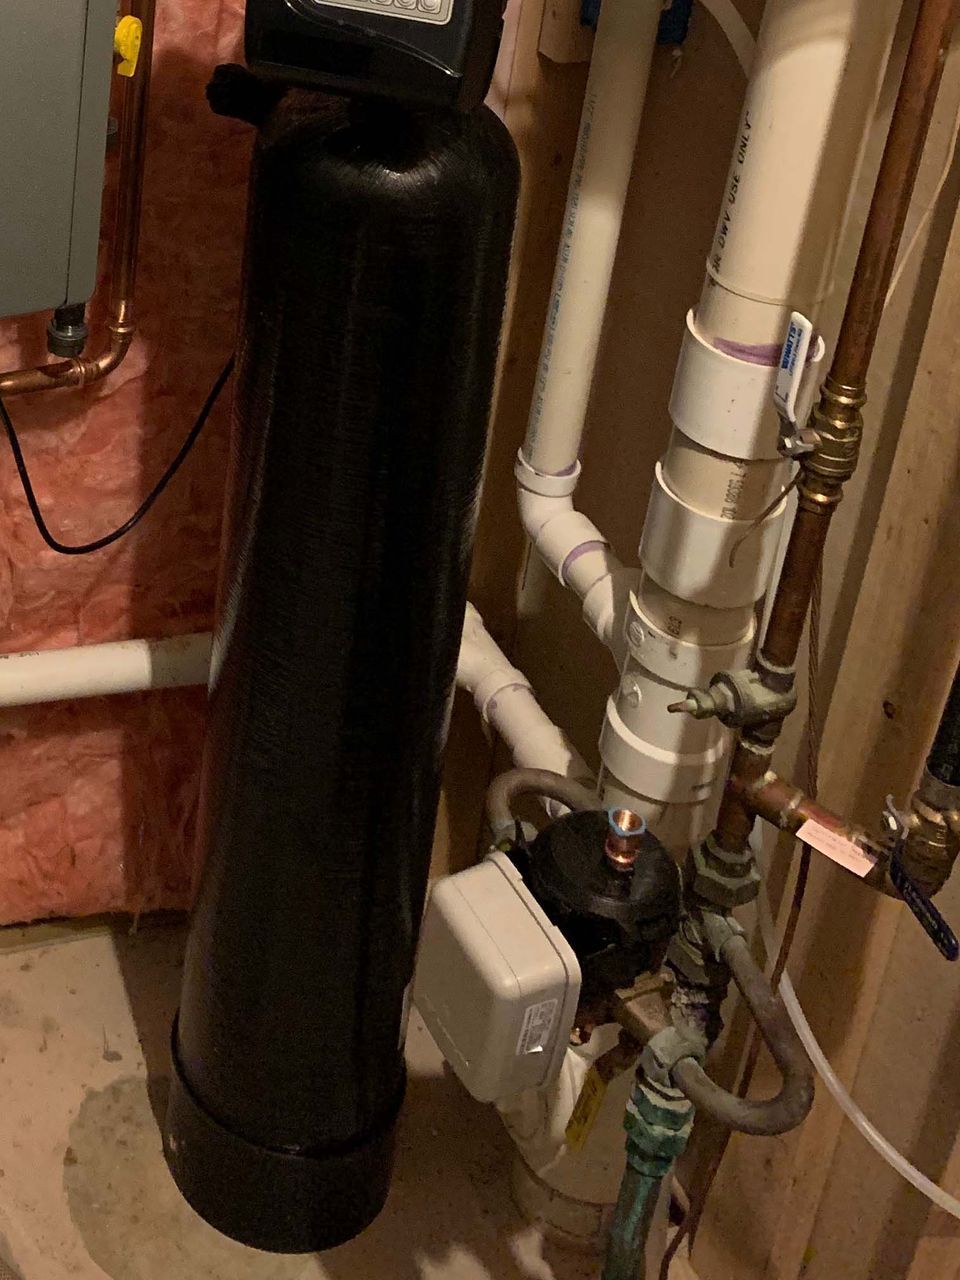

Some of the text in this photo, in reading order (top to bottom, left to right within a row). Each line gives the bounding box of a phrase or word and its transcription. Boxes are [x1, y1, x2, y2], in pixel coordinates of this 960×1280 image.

[723, 172, 744, 206] USE
[713, 209, 736, 249] DWV
[781, 321, 799, 360] WATTS
